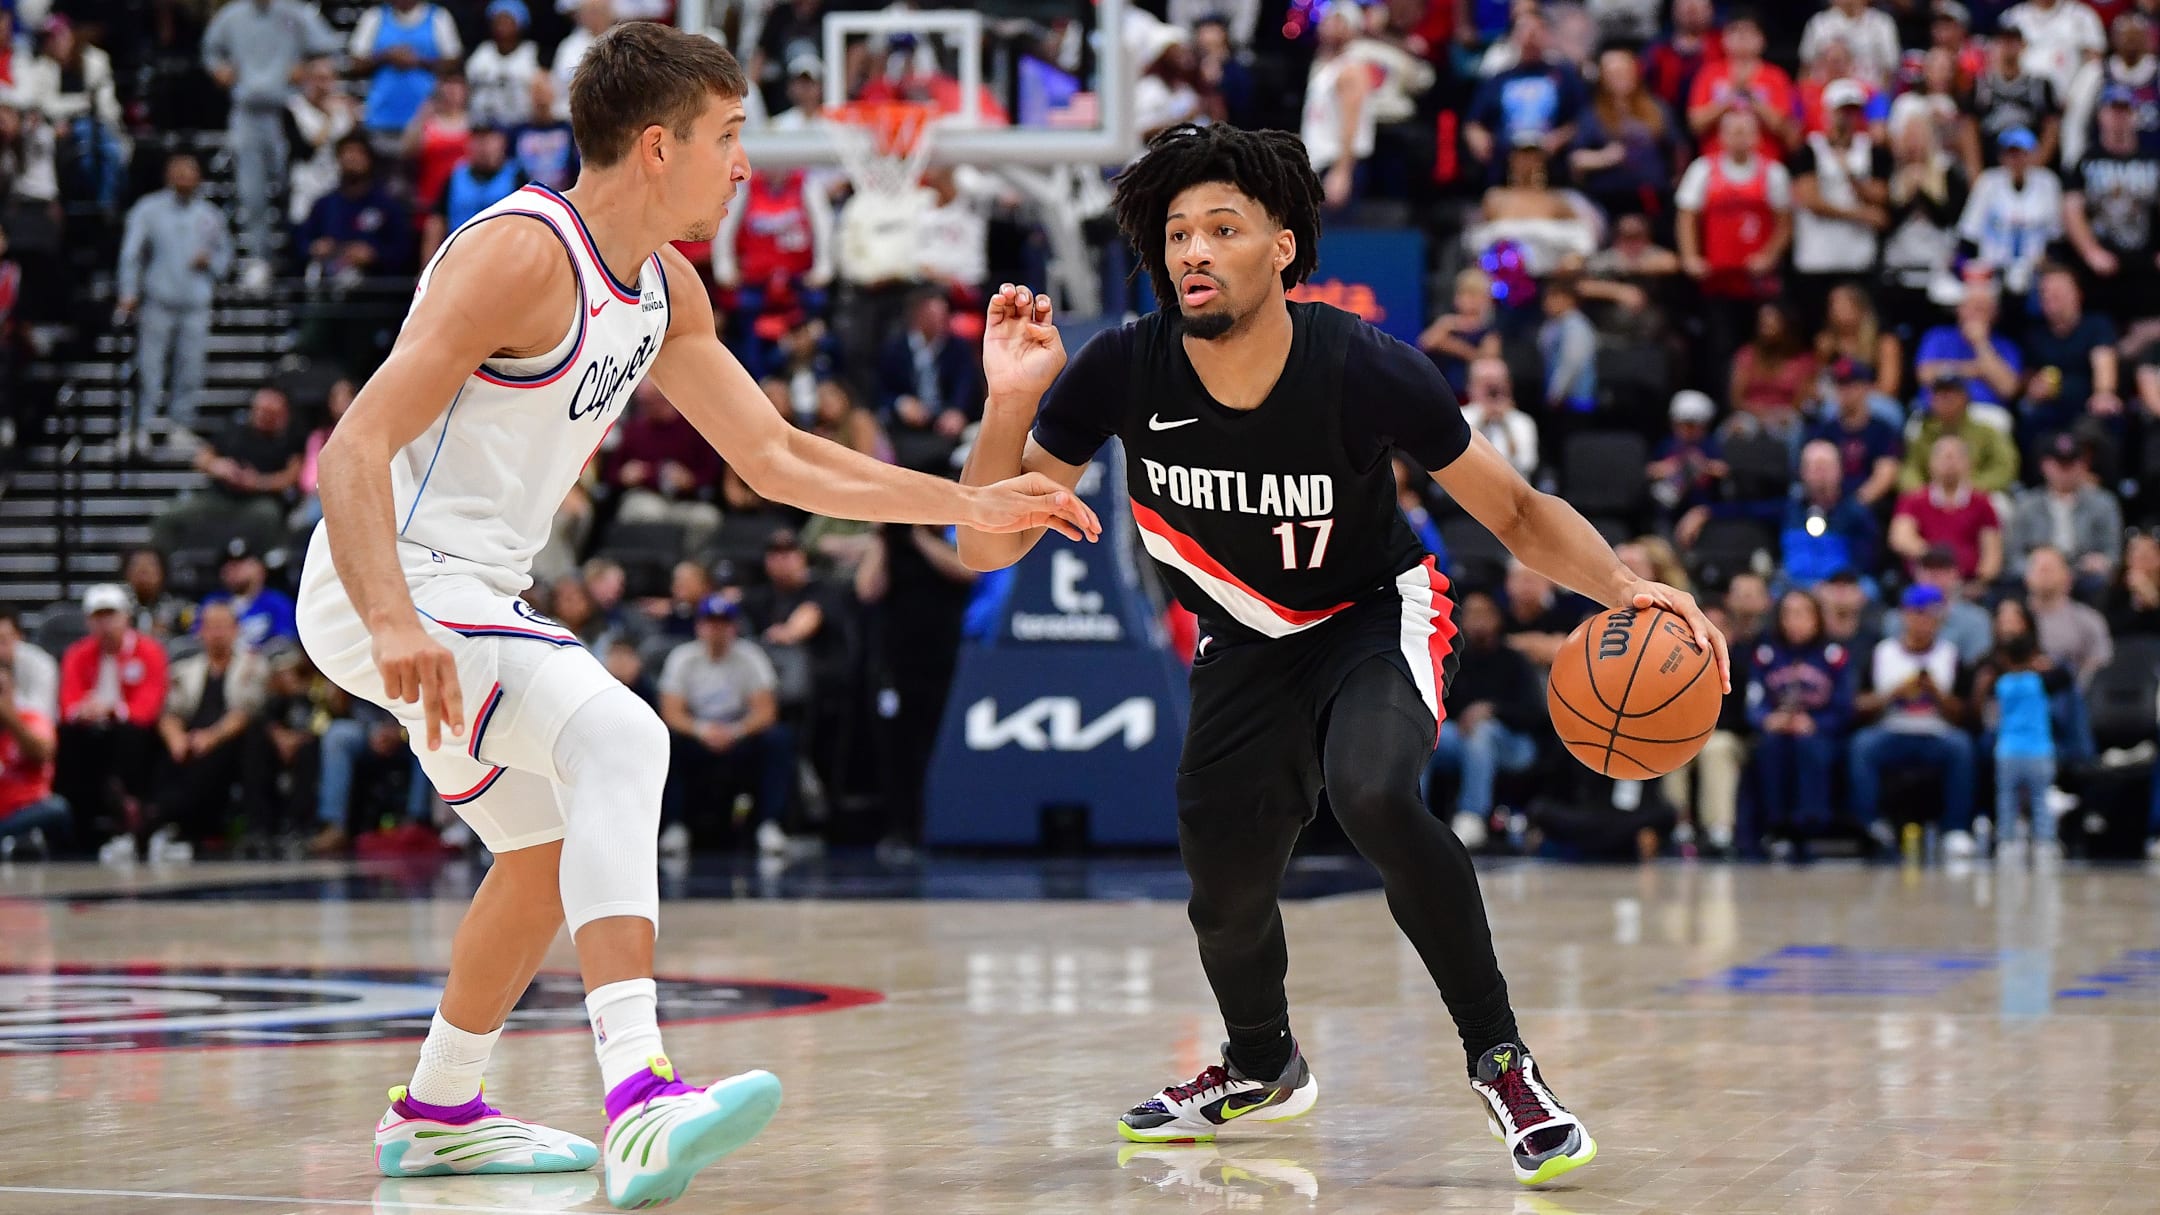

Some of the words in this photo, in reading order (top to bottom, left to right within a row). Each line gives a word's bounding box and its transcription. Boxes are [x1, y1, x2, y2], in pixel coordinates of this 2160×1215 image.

[1140, 457, 1334, 517] PORTLAND
[1272, 518, 1334, 570] 17
[1599, 606, 1639, 660] Wil
[965, 696, 1157, 751] KIA
